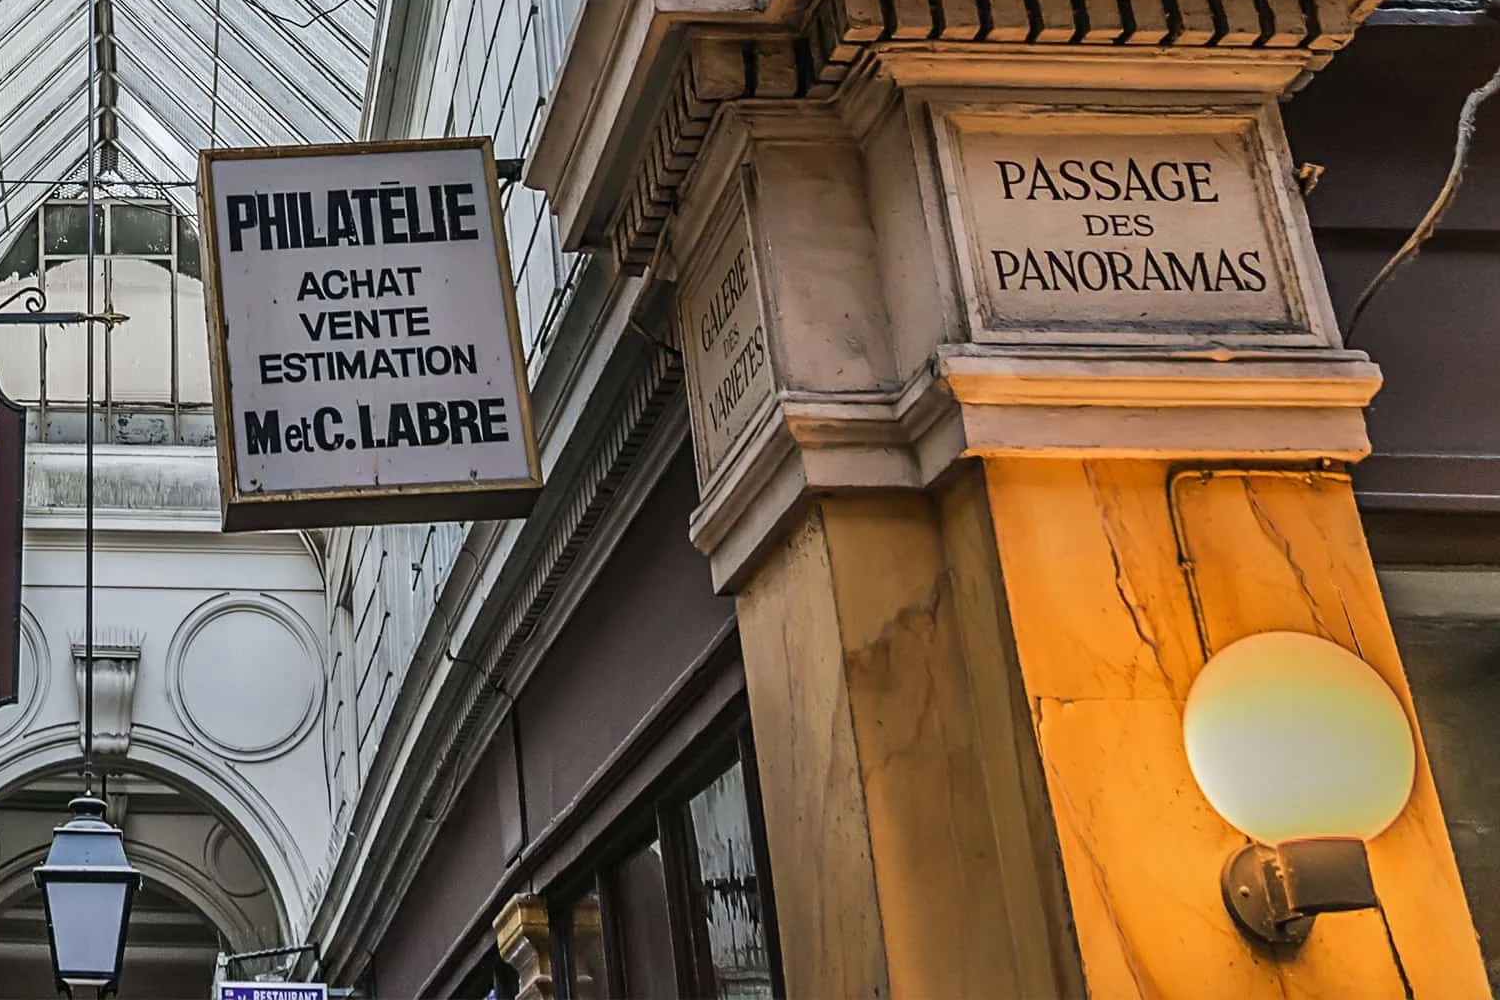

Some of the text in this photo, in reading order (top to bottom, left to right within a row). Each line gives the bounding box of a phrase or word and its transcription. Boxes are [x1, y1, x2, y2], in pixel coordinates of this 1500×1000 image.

[993, 158, 1219, 203] PASSAGE
[1082, 214, 1154, 237] DES
[297, 267, 422, 301] ACHAT
[991, 248, 1267, 292] PANORAMAS
[702, 248, 749, 352] GALERIE
[299, 307, 430, 341] VENTE
[723, 322, 740, 360] DES
[259, 344, 478, 384] ESTIMATION
